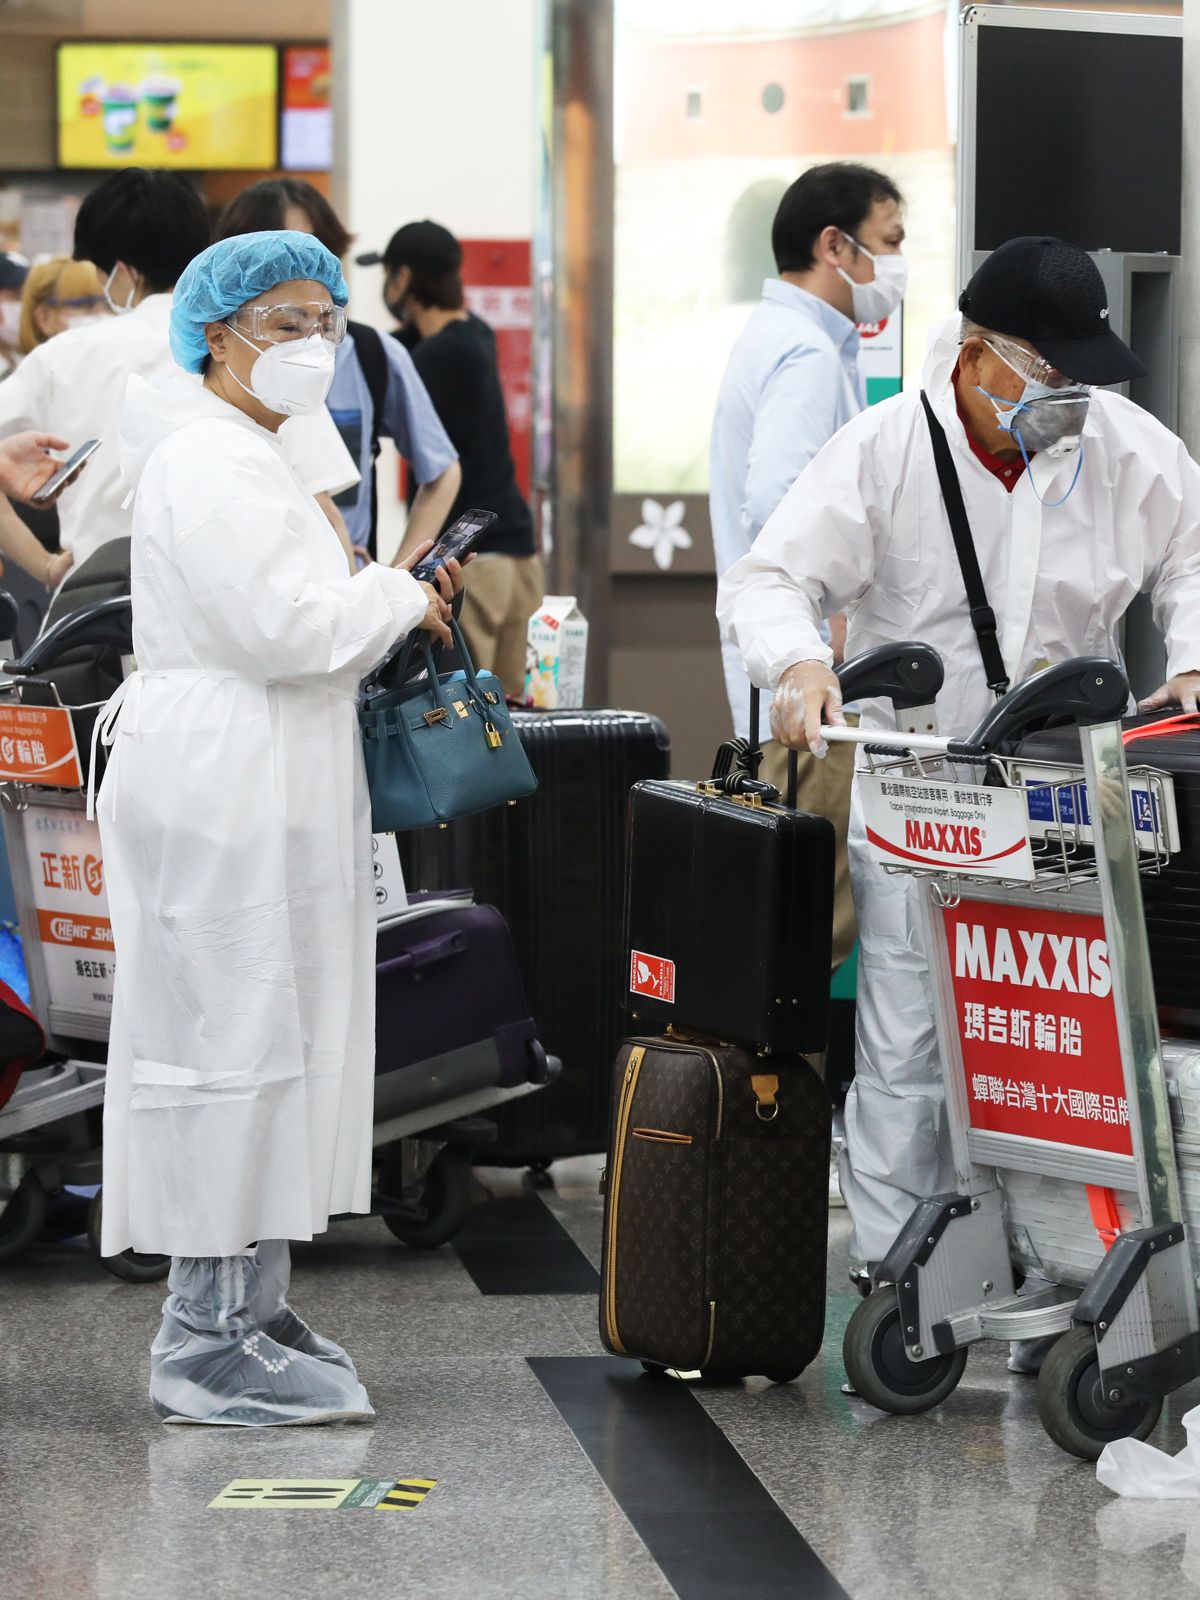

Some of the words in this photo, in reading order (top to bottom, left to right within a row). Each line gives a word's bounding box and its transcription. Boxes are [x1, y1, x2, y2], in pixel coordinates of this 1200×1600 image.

[905, 819, 982, 856] MAXXIS
[40, 852, 82, 891] 正新
[50, 917, 91, 942] CHENG
[955, 922, 1113, 998] MAXXIS
[964, 1001, 1082, 1057] 瑪吉斯輪胎
